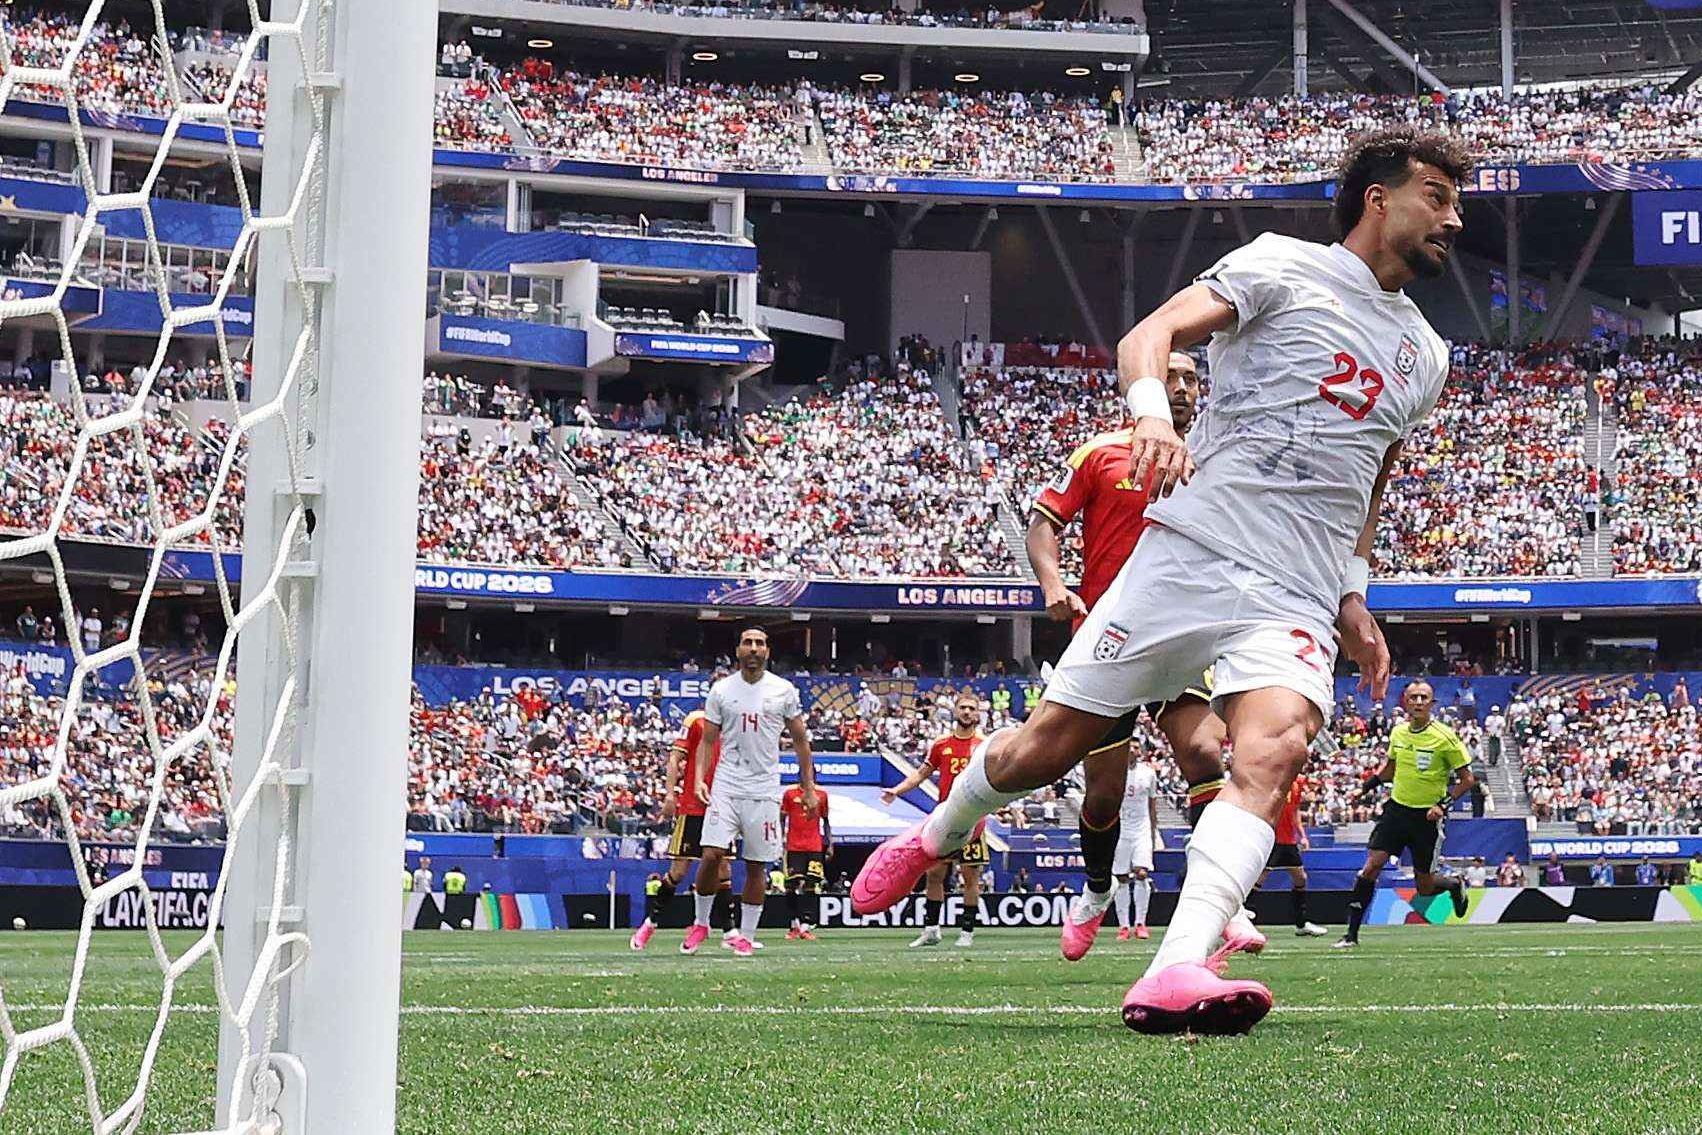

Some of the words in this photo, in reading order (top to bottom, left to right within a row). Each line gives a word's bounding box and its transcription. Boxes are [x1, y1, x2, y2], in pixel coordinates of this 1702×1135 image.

[1319, 352, 1384, 421] 23
[450, 572, 486, 590] CUP
[487, 574, 553, 594] 2026
[898, 588, 938, 604] LOS
[942, 588, 1033, 605] ANGELES
[741, 713, 758, 732] 14
[962, 844, 981, 860] 23
[1554, 841, 1602, 855] WORLD
[1604, 841, 1630, 854] CUP
[1036, 855, 1064, 867] LOS
